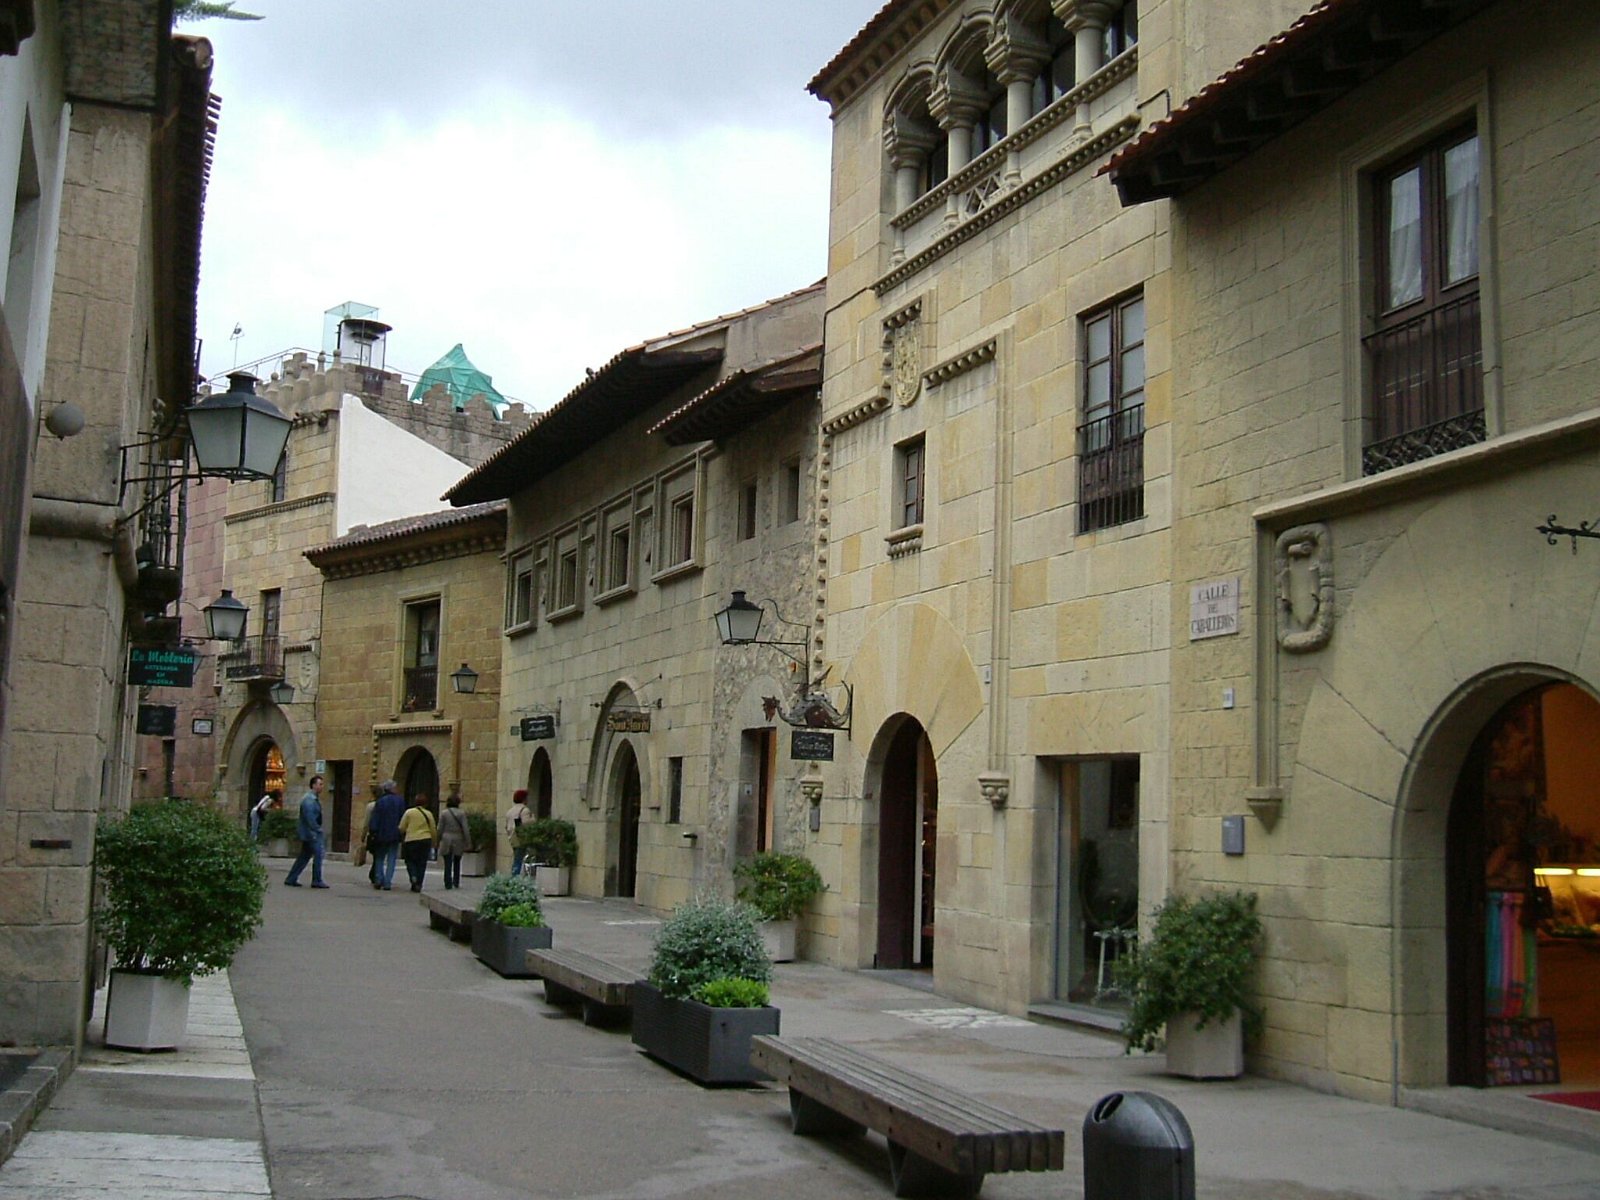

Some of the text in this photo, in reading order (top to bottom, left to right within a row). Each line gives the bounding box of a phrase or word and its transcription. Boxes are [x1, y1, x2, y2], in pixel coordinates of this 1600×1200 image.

[1198, 584, 1229, 601] CALLE
[1207, 603, 1217, 614] DE
[1191, 614, 1235, 633] CABALLEROS
